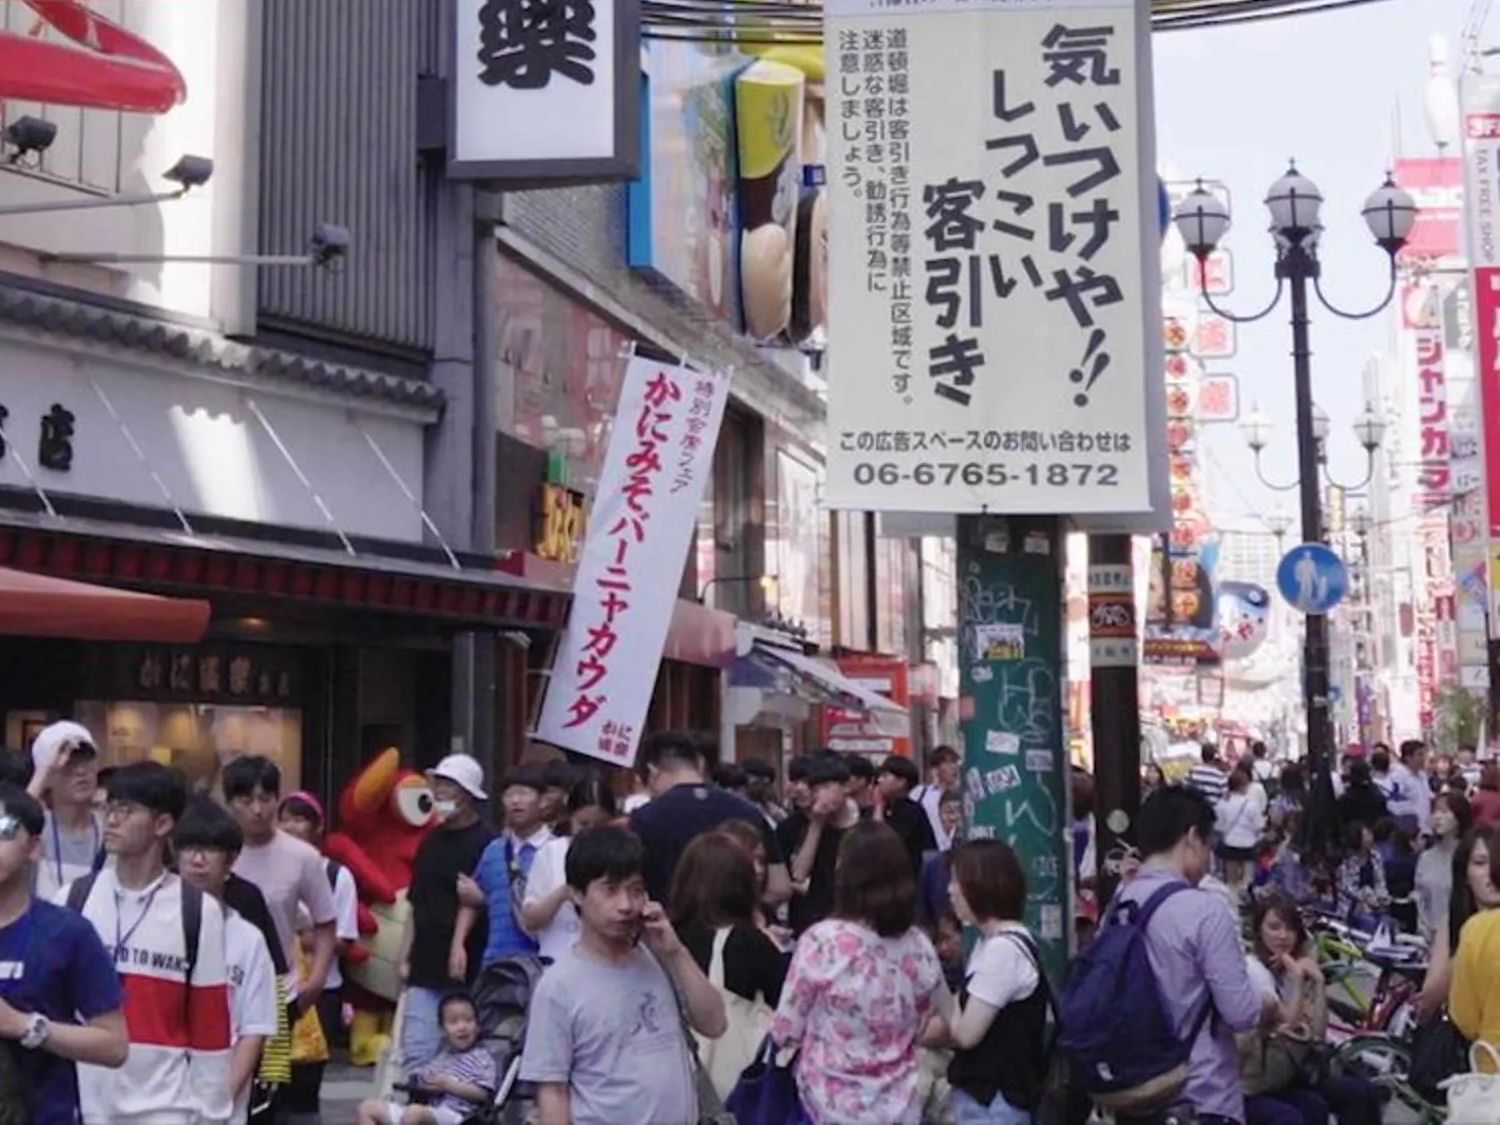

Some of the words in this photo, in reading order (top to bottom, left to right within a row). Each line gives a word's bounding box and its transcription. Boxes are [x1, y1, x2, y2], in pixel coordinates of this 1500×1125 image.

[839, 30, 863, 197] 注意しましょう。
[863, 30, 887, 292] 迷惑な客引き、勧誘行為に
[985, 69, 1043, 298] しつこい
[923, 177, 986, 407] 客引き
[563, 372, 681, 728] かにみそバーニャカウダ
[840, 431, 1131, 453] この広告スペースのお問い合わせは
[853, 463, 1119, 486] 06-6765-1872
